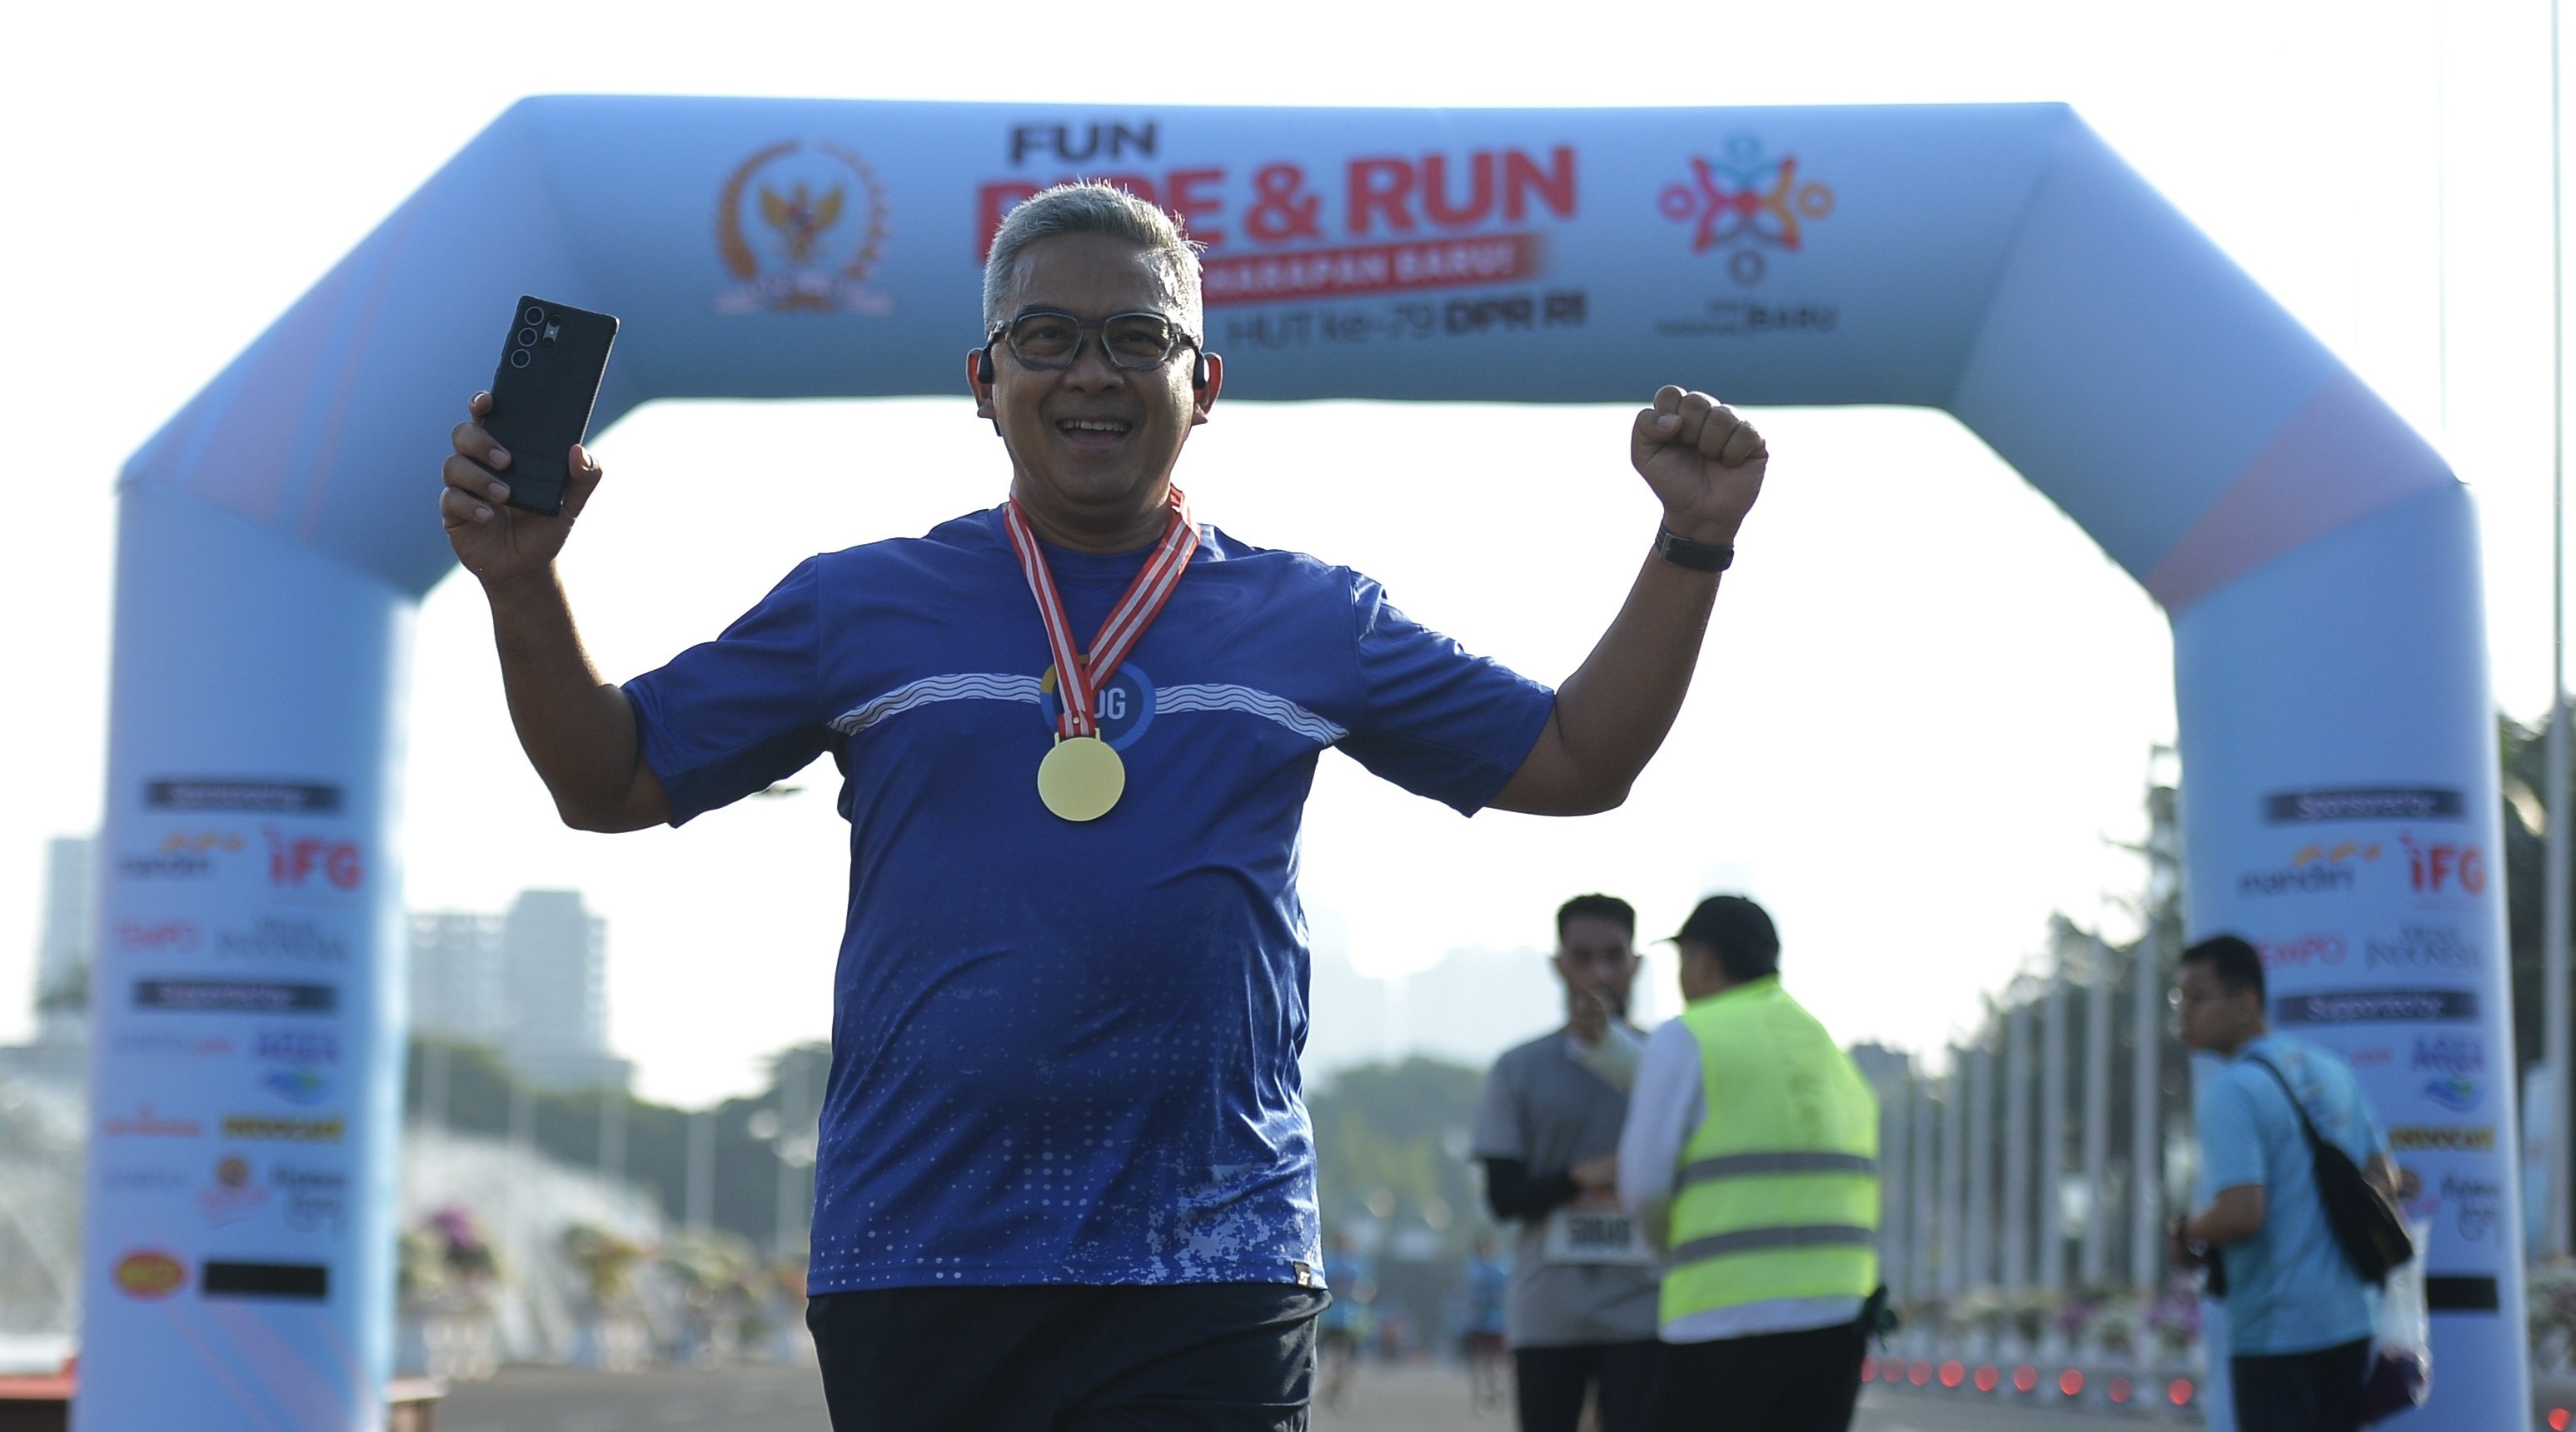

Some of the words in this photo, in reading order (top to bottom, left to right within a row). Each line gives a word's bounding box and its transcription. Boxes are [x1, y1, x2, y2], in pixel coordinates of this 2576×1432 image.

[1009, 120, 1158, 167] FUN
[1243, 162, 1323, 244] &
[1344, 144, 1578, 236] RUN
[1225, 311, 1313, 350] HUT
[1445, 292, 1533, 332] DPR
[1544, 288, 1587, 327] RI
[2256, 934, 2349, 968] EMPO
